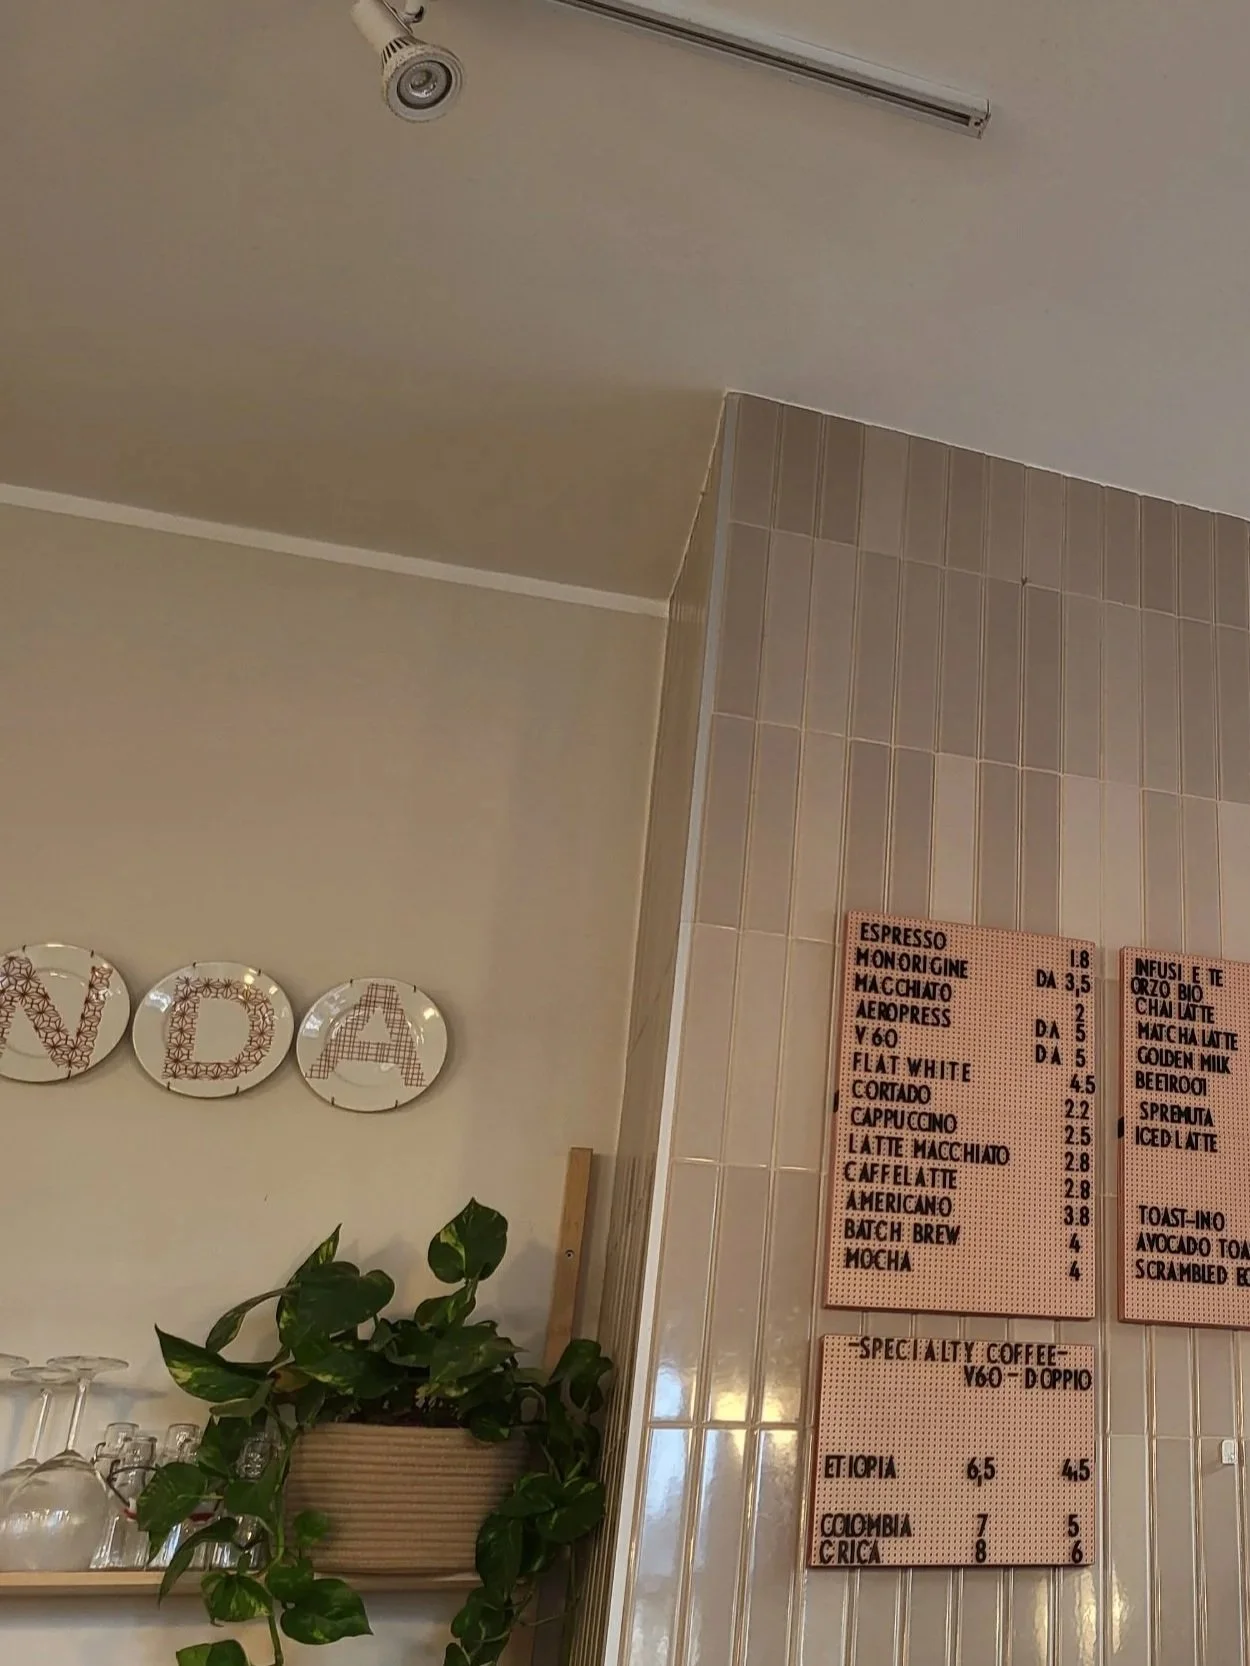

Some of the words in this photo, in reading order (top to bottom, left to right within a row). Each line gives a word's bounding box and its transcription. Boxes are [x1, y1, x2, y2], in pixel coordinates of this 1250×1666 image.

[860, 922, 947, 951] ESPRESSO
[1070, 949, 1090, 969] 1.8
[855, 947, 969, 979] MONORIGINE
[1036, 969, 1057, 989] DA
[1065, 972, 1091, 998] 3,5
[1135, 958, 1182, 981] INFUSI
[1192, 966, 1201, 984] E
[1208, 968, 1223, 987] TE
[854, 972, 952, 1002] MACCHIATO
[1075, 1003, 1085, 1022] 2
[1131, 976, 1171, 999] ORZO
[1178, 983, 1203, 1003] BIO
[856, 1000, 951, 1028] AEROPRESS
[1035, 1019, 1060, 1040] DA
[1075, 1023, 1086, 1042] 5
[1135, 997, 1173, 1019] CHAI
[1178, 1002, 1215, 1024] LATTE
[1138, 1021, 1198, 1047] MATCHA
[1202, 1031, 1239, 1051] LATTE
[1035, 1044, 1061, 1065] DA
[1075, 1048, 1086, 1068] 5
[1137, 1046, 1193, 1071] GOLDEN
[1200, 1053, 1231, 1074] MILK
[853, 1051, 900, 1075] FLAT
[907, 1057, 972, 1083] WHITE
[1070, 1073, 1096, 1095] 4.5
[1135, 1071, 1207, 1097] BEETROOT
[852, 1079, 932, 1105] CORTADO
[1064, 1098, 1090, 1120] 2.2
[1140, 1101, 1214, 1127] SPREMUTA
[851, 1106, 958, 1134] CAPPUCCINO
[1065, 1125, 1091, 1146] 2.5
[1135, 1126, 1172, 1147] ICED
[1175, 1130, 1218, 1152] LATTE
[849, 1133, 904, 1157] LATTE
[913, 1139, 1010, 1166] MACCHIATO
[1065, 1151, 1090, 1172] 2.8
[844, 1161, 957, 1189] CAFFELATTE
[1064, 1178, 1091, 1200] 2.8
[845, 1189, 952, 1217] AMERICANO
[1063, 1205, 1090, 1226] 3.8
[1138, 1205, 1225, 1231] TOAST-INO
[844, 1218, 902, 1242] BATCH
[912, 1223, 961, 1245] BREW
[1069, 1232, 1081, 1253] 4
[1136, 1232, 1211, 1257] AVOCADO
[844, 1247, 912, 1272] MOCHA
[1069, 1260, 1081, 1281] 4
[1135, 1259, 1228, 1285] SCRAMBLED
[824, 1455, 897, 1479] ETIOPIA
[967, 1456, 996, 1487] 6,5
[820, 1512, 912, 1538] COLOMBIA
[976, 1513, 989, 1538] 7
[1067, 1514, 1080, 1538] 5
[975, 1539, 987, 1563] 8
[1071, 1540, 1083, 1564] 6
